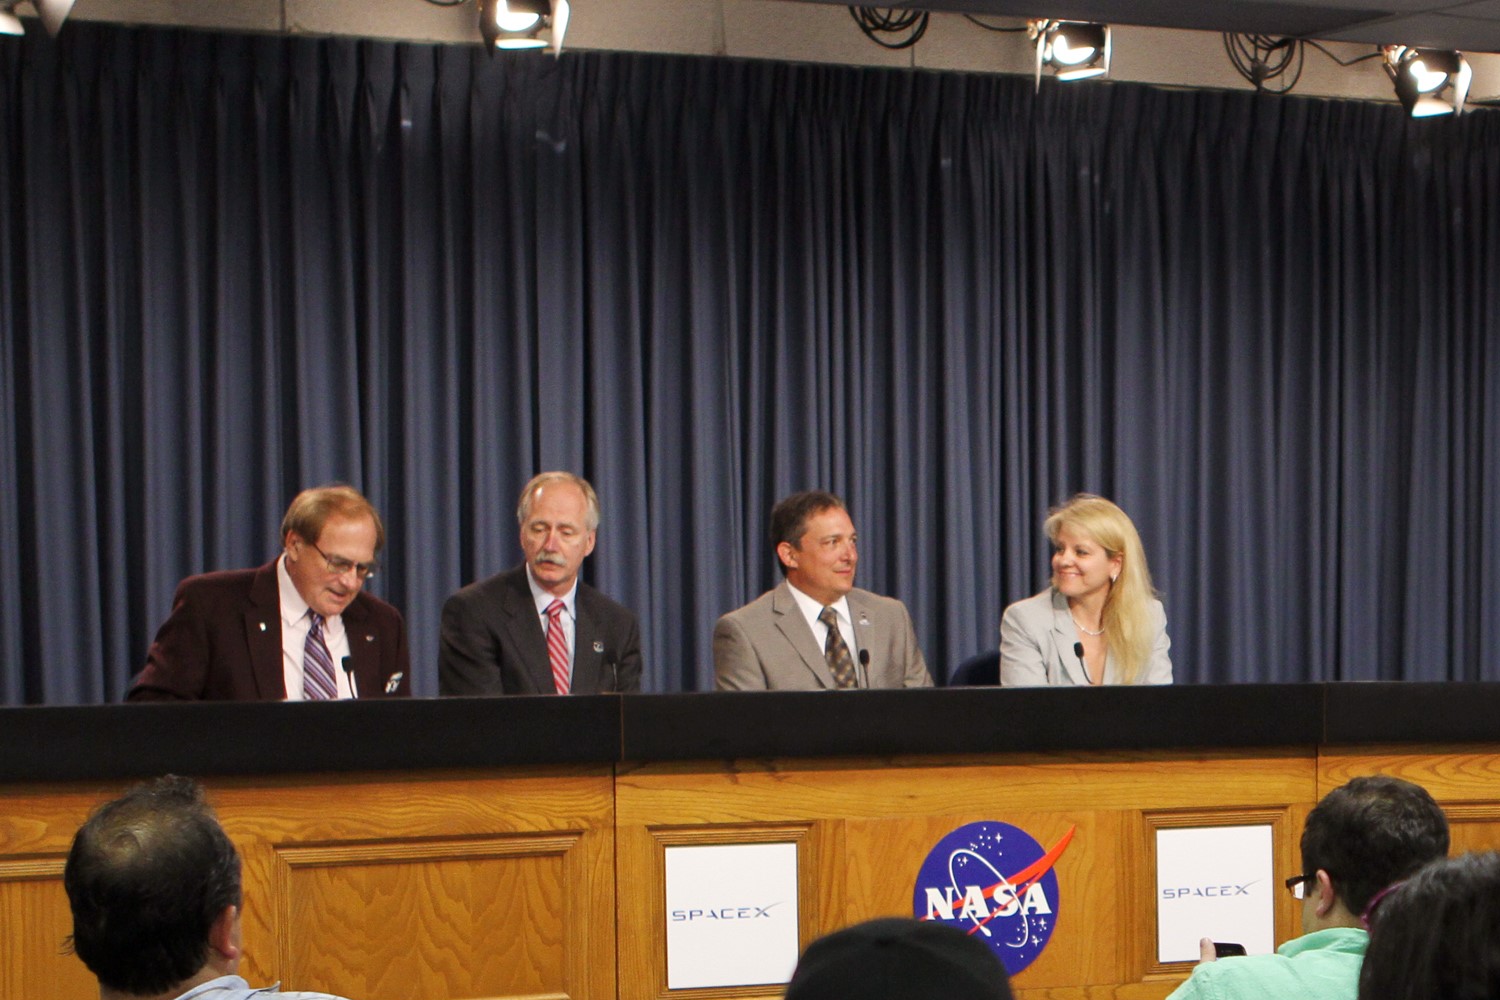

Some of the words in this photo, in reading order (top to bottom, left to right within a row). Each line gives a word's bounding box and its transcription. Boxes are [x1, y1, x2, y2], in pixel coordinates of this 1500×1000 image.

[1163, 880, 1260, 899] SPACEX
[672, 901, 784, 921] SPACEX
[925, 882, 1052, 920] NASA
